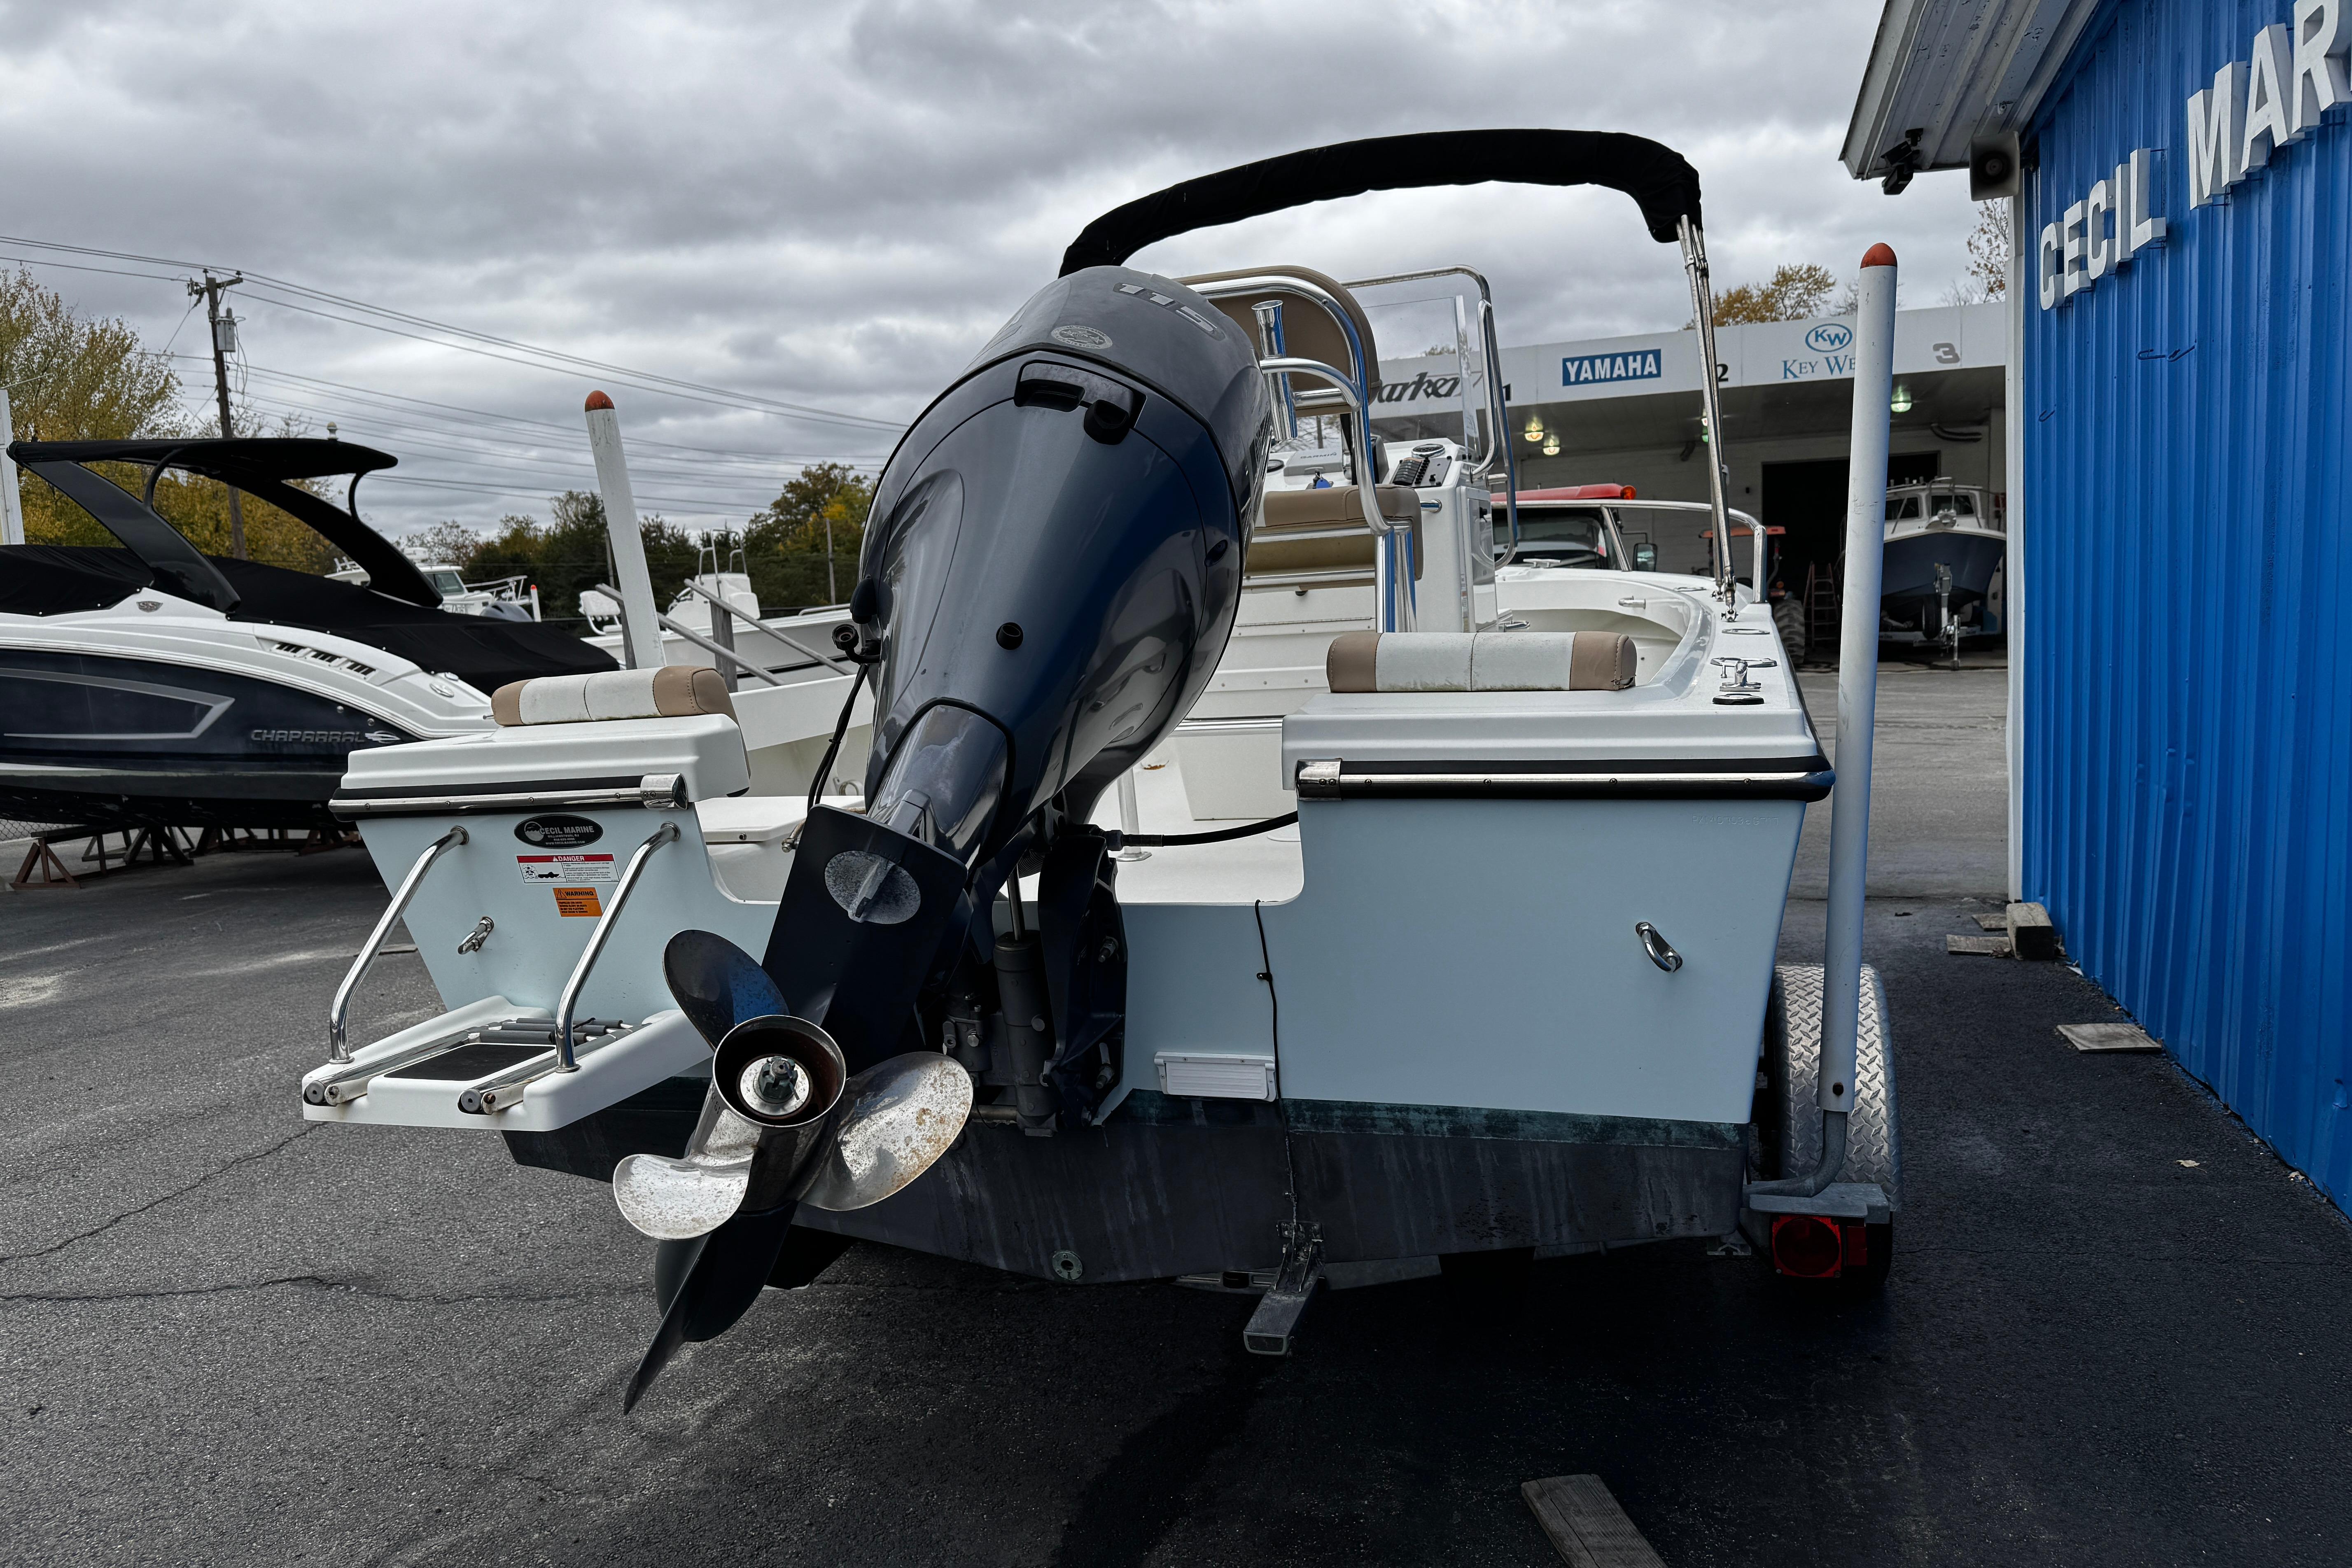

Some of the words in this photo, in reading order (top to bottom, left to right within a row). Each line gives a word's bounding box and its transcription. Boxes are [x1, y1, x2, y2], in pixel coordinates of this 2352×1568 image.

[2040, 149, 2164, 310] CECIL
[2188, 0, 2352, 210] MAR
[1815, 329, 1847, 346] KW
[1932, 343, 1960, 364] 3
[1566, 354, 1657, 382] YAMAHA
[1716, 363, 1729, 382] 2
[1824, 355, 1855, 376] WE
[1377, 372, 1460, 403] arker
[1503, 383, 1511, 401] 1
[251, 730, 365, 742] CHAPARRAL
[539, 827, 562, 835] CECIL
